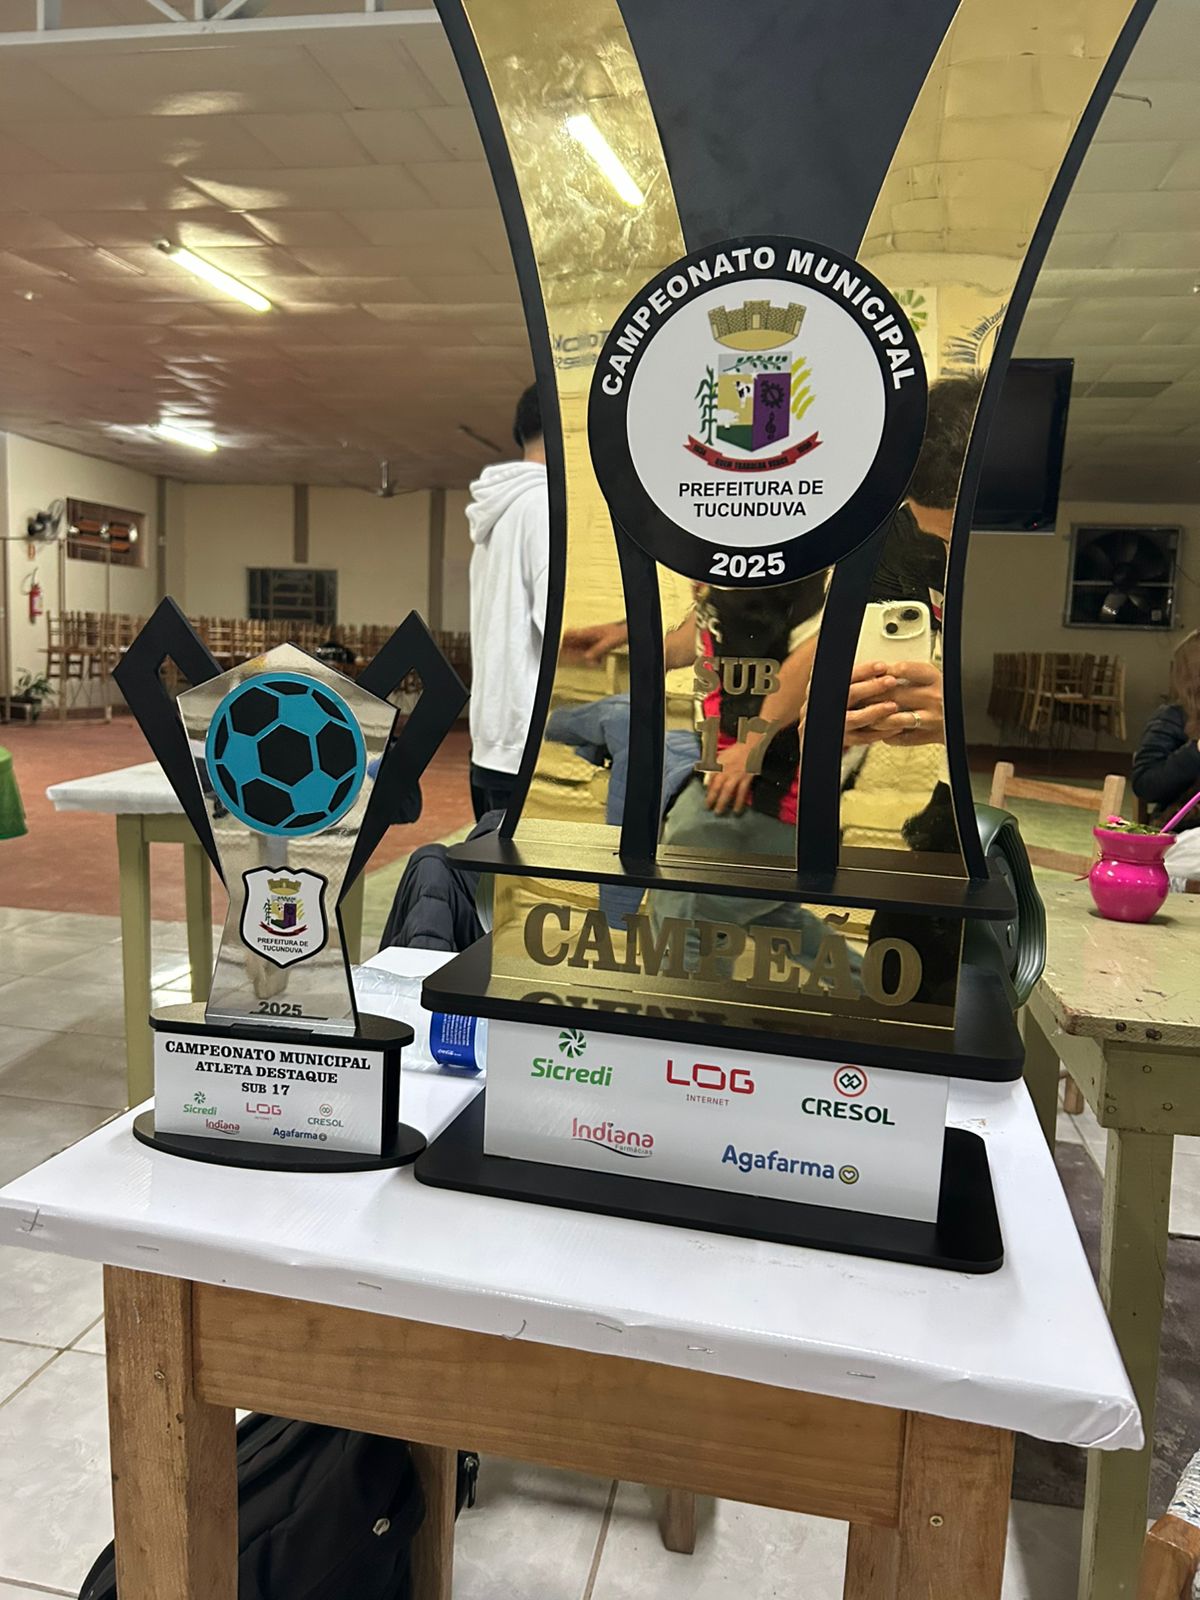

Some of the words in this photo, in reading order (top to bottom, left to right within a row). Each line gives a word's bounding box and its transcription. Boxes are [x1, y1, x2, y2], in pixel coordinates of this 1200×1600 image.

[601, 246, 775, 396] CAMPEONATO
[786, 248, 916, 391] MUNICIPAL
[678, 480, 792, 498] PREFEITURA
[798, 479, 824, 495] DE
[693, 501, 807, 518] TUCUNDUVA
[708, 551, 786, 578] 2025
[693, 656, 782, 696] SUB
[693, 715, 780, 776] 17
[257, 937, 298, 947] PREFEITURA
[299, 940, 309, 948] DE
[263, 944, 303, 954] TUCUNDUVA
[523, 902, 923, 1007] CAMPEÃO
[257, 1001, 303, 1017] 2025
[165, 1040, 276, 1063] CAMPEONATO
[279, 1051, 371, 1070] MUNICIPAL
[195, 1061, 253, 1077] ATLETA
[255, 1067, 338, 1084] DESTAQUE
[530, 1057, 613, 1087] Sicredi
[666, 1059, 755, 1095] LOG
[241, 1082, 267, 1095] SUB
[272, 1083, 290, 1097] 17
[685, 1093, 730, 1107] INTERNET
[183, 1103, 218, 1117] Sicredi
[246, 1102, 282, 1116] LOG
[801, 1097, 896, 1126] CRESOL
[205, 1119, 240, 1132] Indiana
[307, 1117, 345, 1129] CRESOL
[572, 1117, 654, 1149] Indiana
[272, 1127, 319, 1142] Agafarma
[721, 1143, 835, 1181] Agafarma
